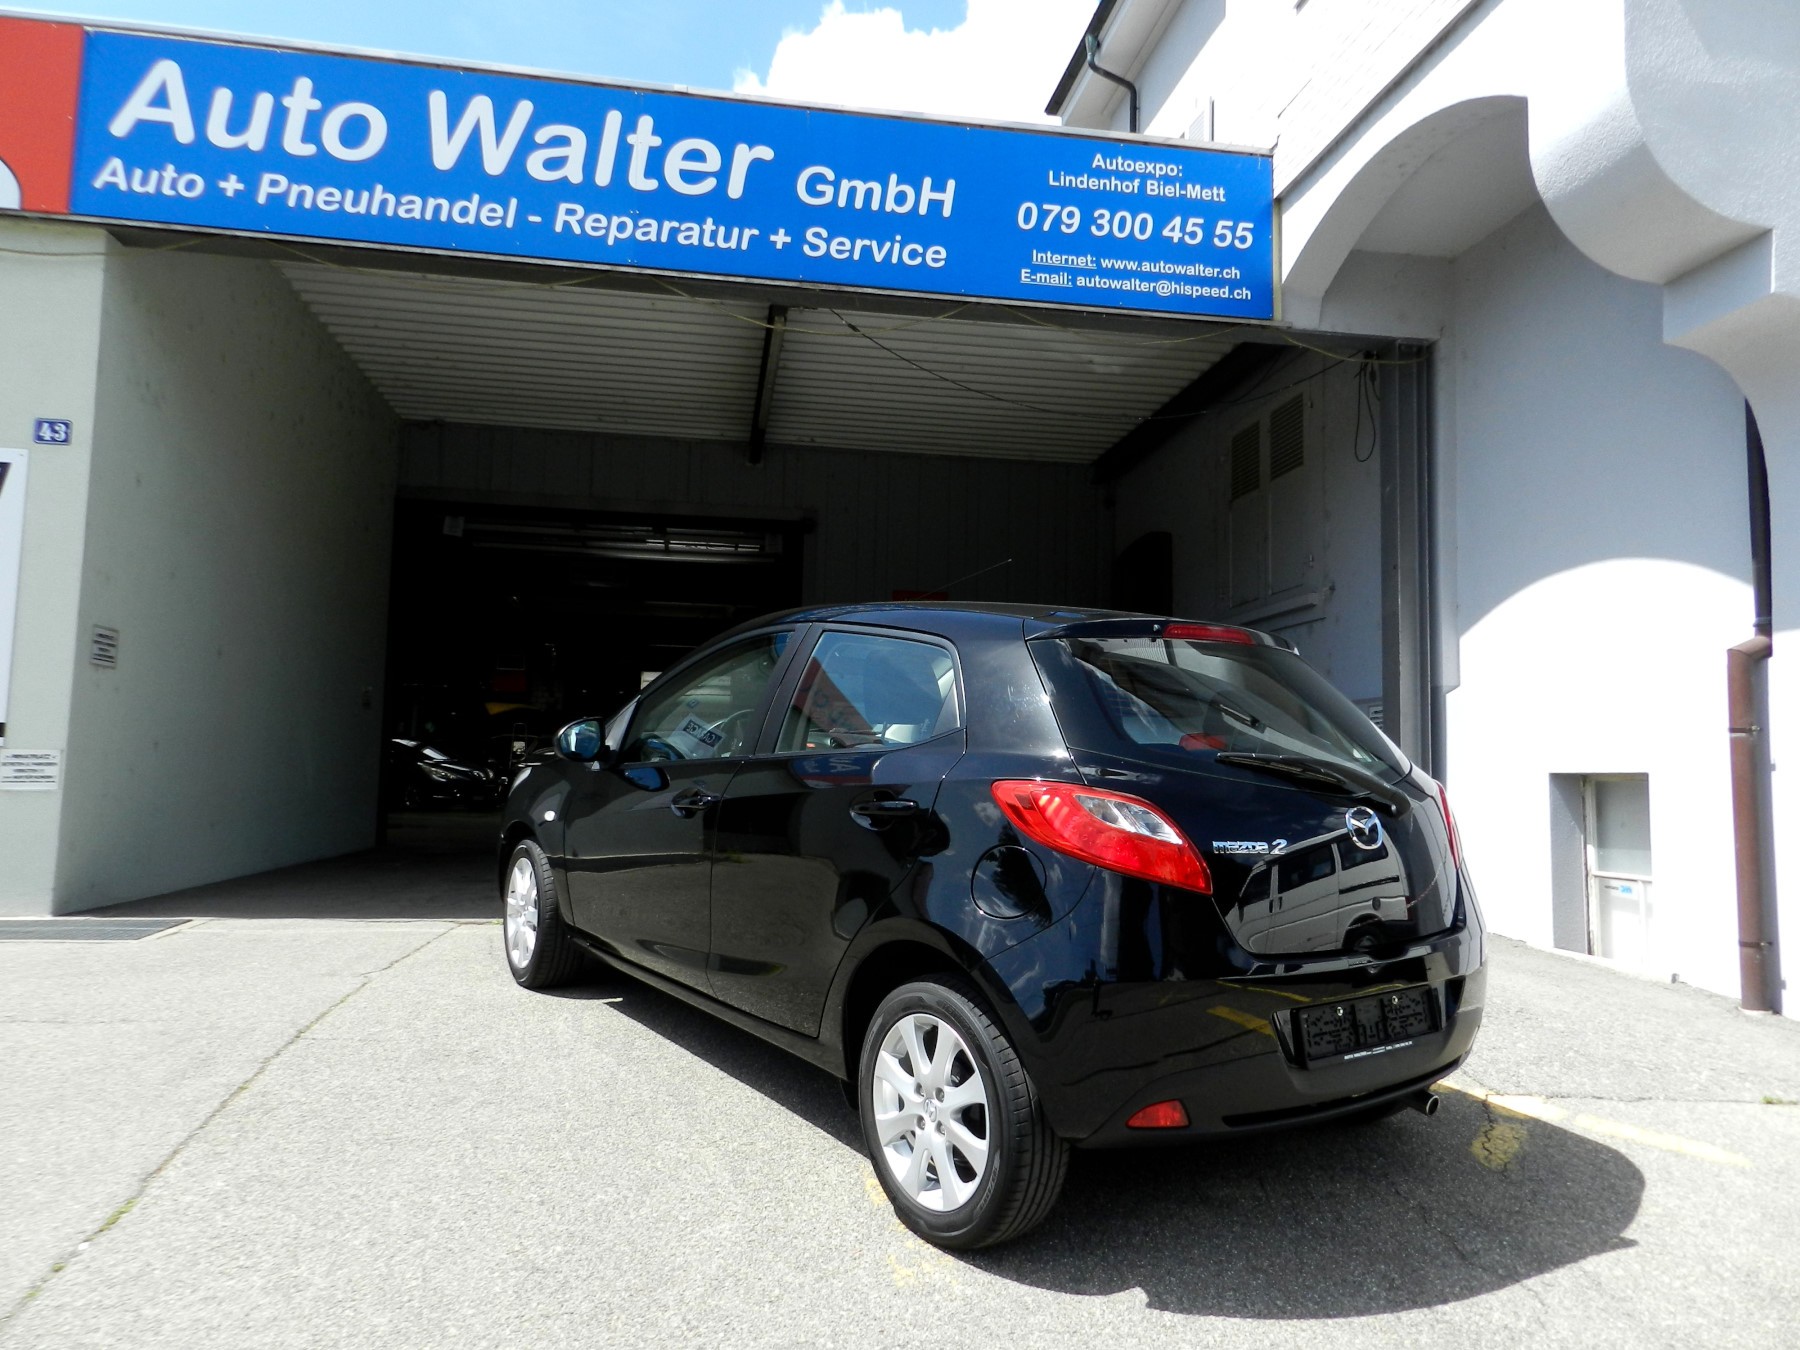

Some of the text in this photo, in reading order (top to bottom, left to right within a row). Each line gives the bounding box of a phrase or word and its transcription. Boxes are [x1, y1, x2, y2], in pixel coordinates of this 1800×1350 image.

[108, 58, 957, 219] Auto Walter GmbH
[1091, 153, 1184, 178] Autoexpo:
[1048, 170, 1226, 203] Lindenhof Biel-Mett
[93, 157, 948, 269] Auto + Pneuhandel - Reparatur + Service
[1016, 201, 1255, 251] 079 300 45 55
[1031, 249, 1241, 280] Internet: www.autowalter.ch
[1020, 268, 1252, 301] E-mail: autowalter@hispeed.ch
[38, 422, 67, 442] 43
[1269, 838, 1288, 855] 2
